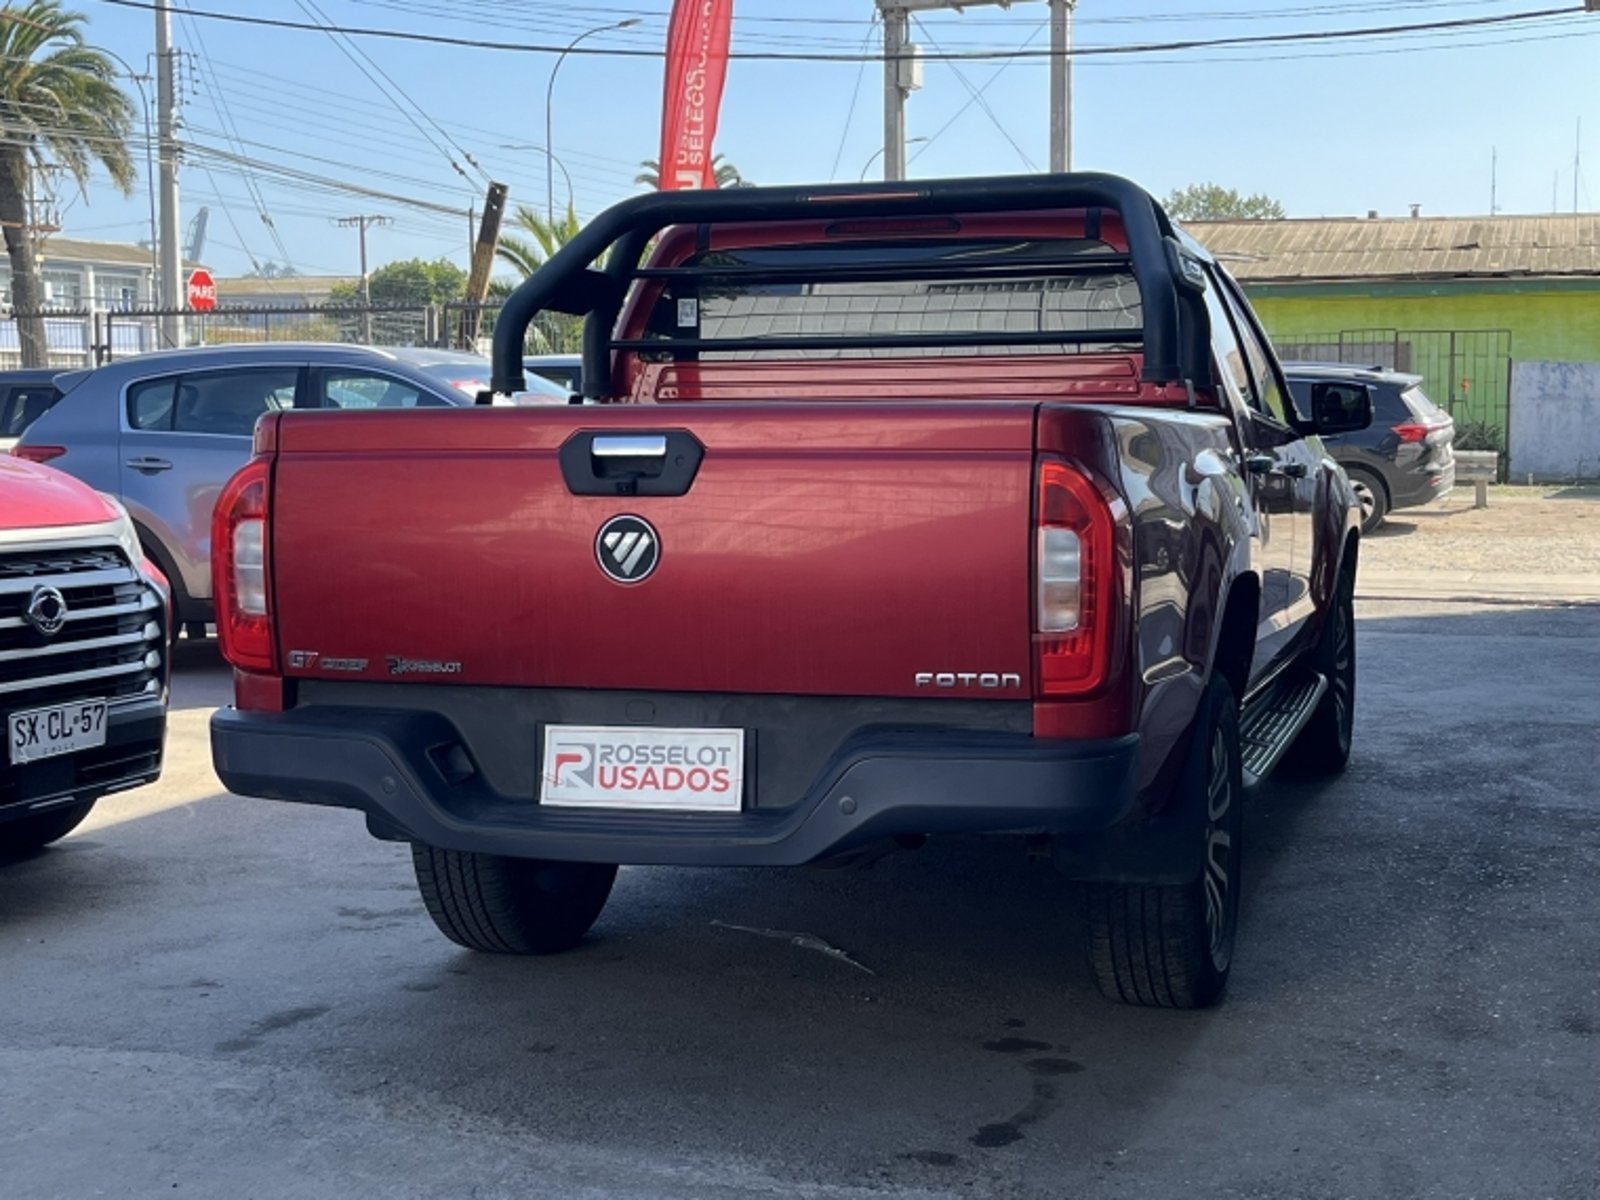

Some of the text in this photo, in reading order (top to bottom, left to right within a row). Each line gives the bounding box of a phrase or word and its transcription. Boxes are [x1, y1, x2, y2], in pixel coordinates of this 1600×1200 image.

[190, 284, 214, 299] PARE
[288, 650, 318, 668] G7
[915, 672, 1020, 687] FOTON
[600, 744, 731, 766] ROSSELOT
[599, 765, 730, 793] USADOS
